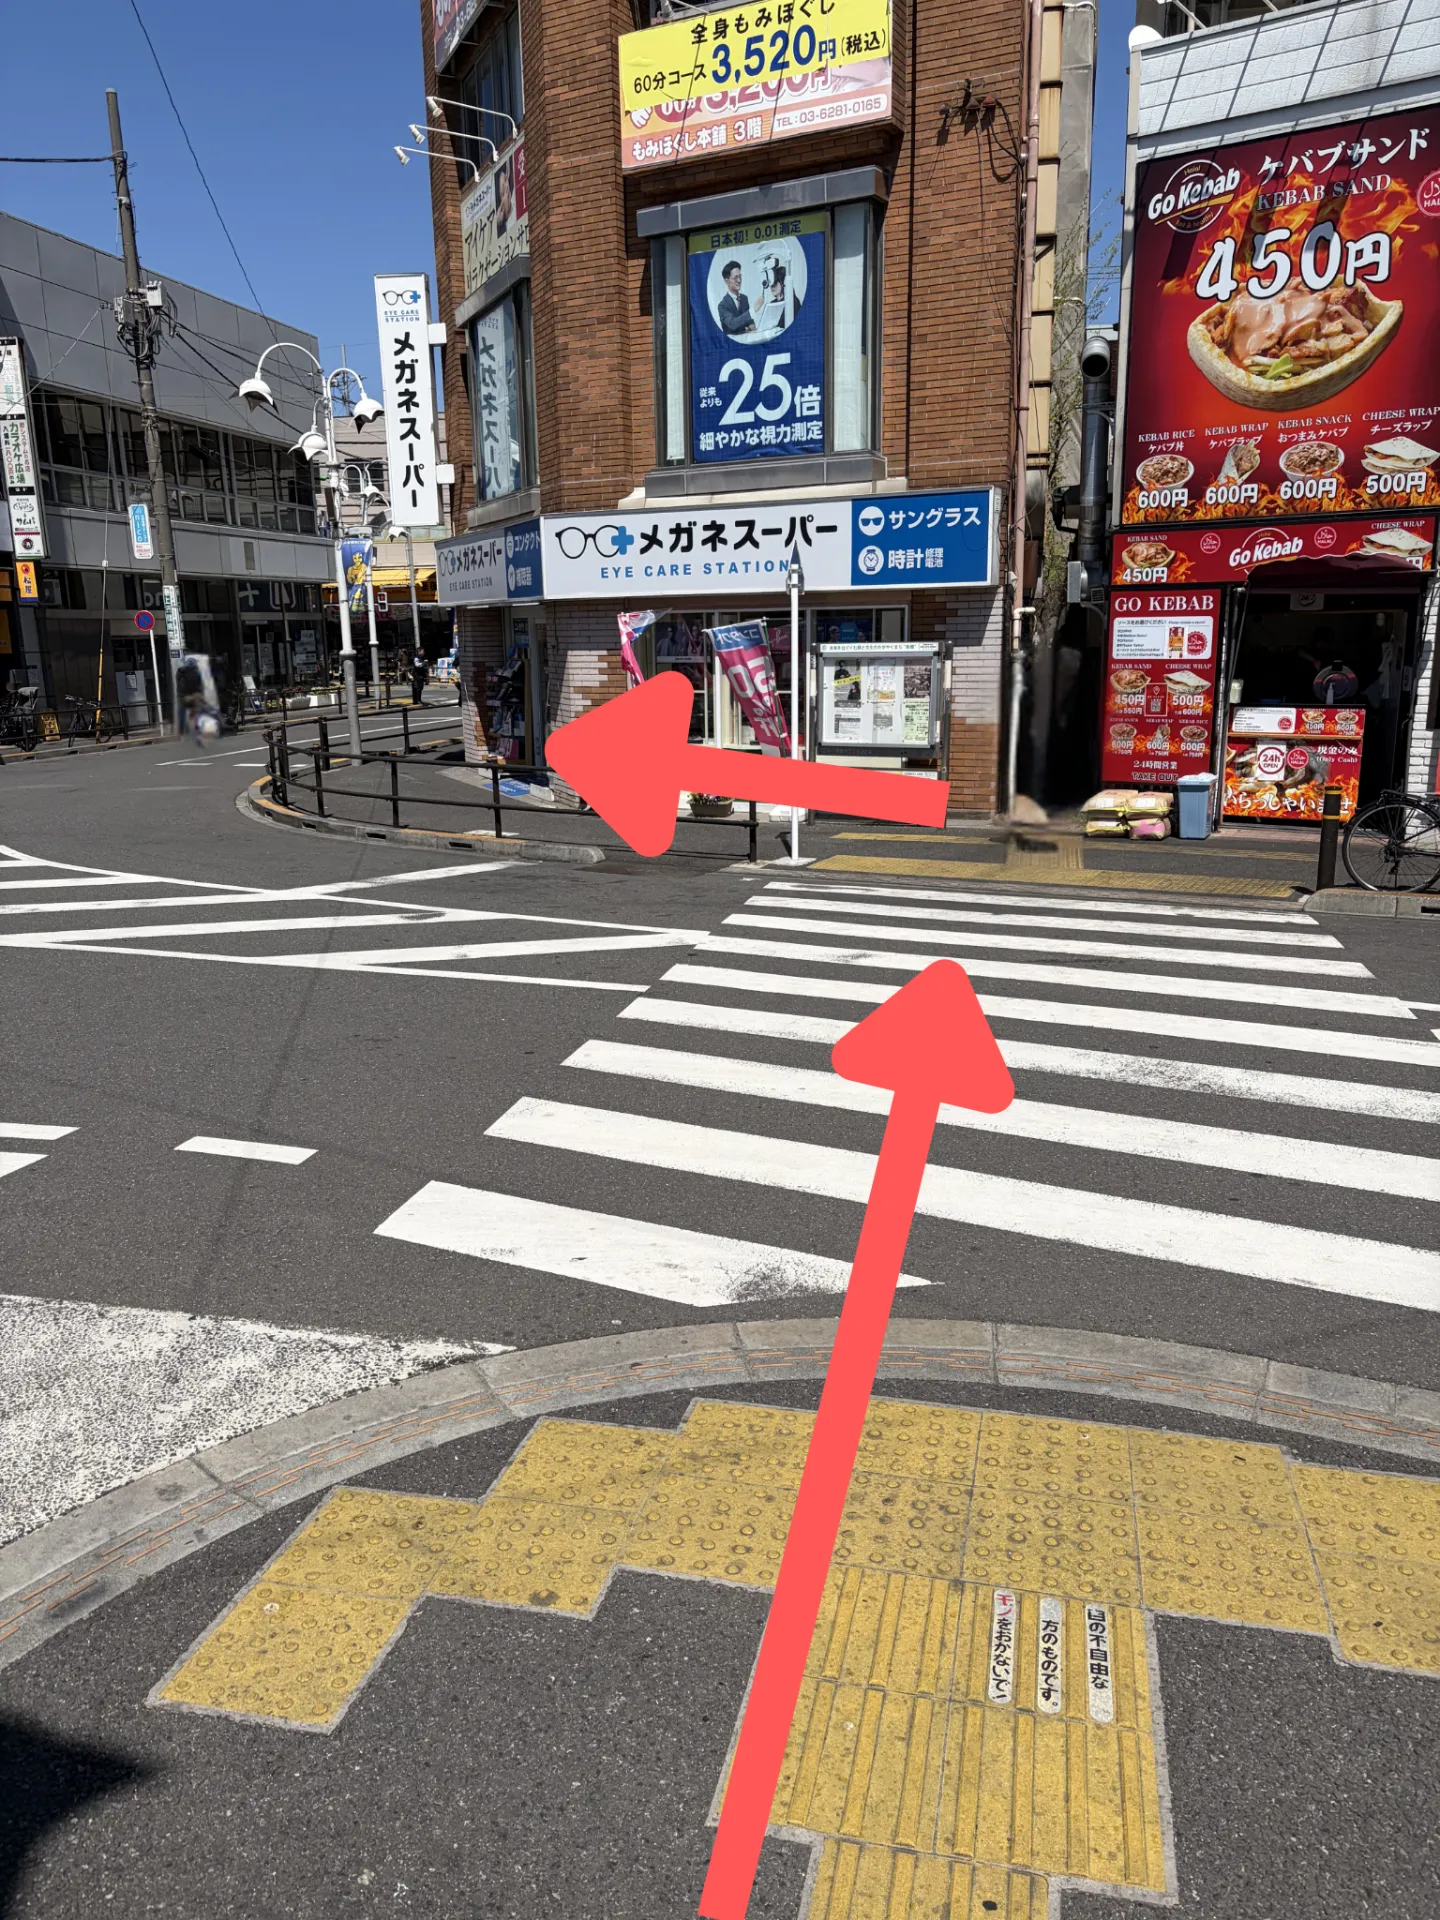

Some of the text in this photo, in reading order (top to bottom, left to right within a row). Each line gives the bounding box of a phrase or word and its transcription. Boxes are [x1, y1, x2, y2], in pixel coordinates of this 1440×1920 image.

[691, 0, 836, 45] 全身もみほぐし
[634, 24, 887, 94] 60分コース 3,520円 (税込)
[632, 115, 763, 162] もみほぐし本舗 3階
[1257, 127, 1431, 186] ケバブサンド
[1148, 167, 1241, 220] Go Kebab
[1256, 173, 1392, 212] KEBAB SAND
[464, 208, 496, 265] アイケア
[710, 219, 802, 249] 日本初! 0.01測定
[1195, 220, 1392, 302] 450円
[699, 386, 717, 398] 従来
[699, 396, 723, 409] よりも
[393, 331, 425, 508] メガネスーパー
[1277, 413, 1353, 429] KEBAB SNACK
[1362, 406, 1440, 421] CHEESE WRAP
[699, 420, 823, 451] 細やかな視力測定
[1138, 429, 1196, 443] KEBAB RICE
[1204, 422, 1269, 437] KEBAB WRAP
[1277, 426, 1349, 443] おつまみケバブ
[1369, 419, 1433, 436] チーズラップ
[8, 421, 26, 484] カラオケ広場
[1147, 441, 1185, 454] ケバブ丼
[1279, 478, 1338, 501] 600円
[1365, 471, 1428, 495] 500円
[1137, 487, 1189, 509] 600円
[1204, 483, 1259, 505] 600円
[888, 506, 982, 530] サングラス
[1371, 519, 1426, 530] CHEESE WRAP
[513, 529, 541, 552] コンタクト
[639, 514, 838, 556] メガネスーパー
[455, 540, 503, 573] メガネスーパー
[888, 548, 924, 569] 時計
[1229, 536, 1304, 567] Go Kebab
[600, 559, 790, 578] EYE CARE STATION
[1122, 567, 1168, 583] 450円
[449, 577, 493, 592] EYE CARE STATION
[1114, 595, 1214, 612] GO KEBAB
[1115, 694, 1145, 706] 450円
[1172, 694, 1204, 706] 500円
[1111, 740, 1134, 750] 600円
[1146, 741, 1170, 751] 600円
[1180, 742, 1206, 752] 600円
[1316, 745, 1358, 756] 現金のみ
[1133, 760, 1178, 770] 24時間営業
[1262, 753, 1281, 763] 24h
[1131, 772, 1179, 781] TAKE OUT
[1039, 1619, 1060, 1707] 方のものです。
